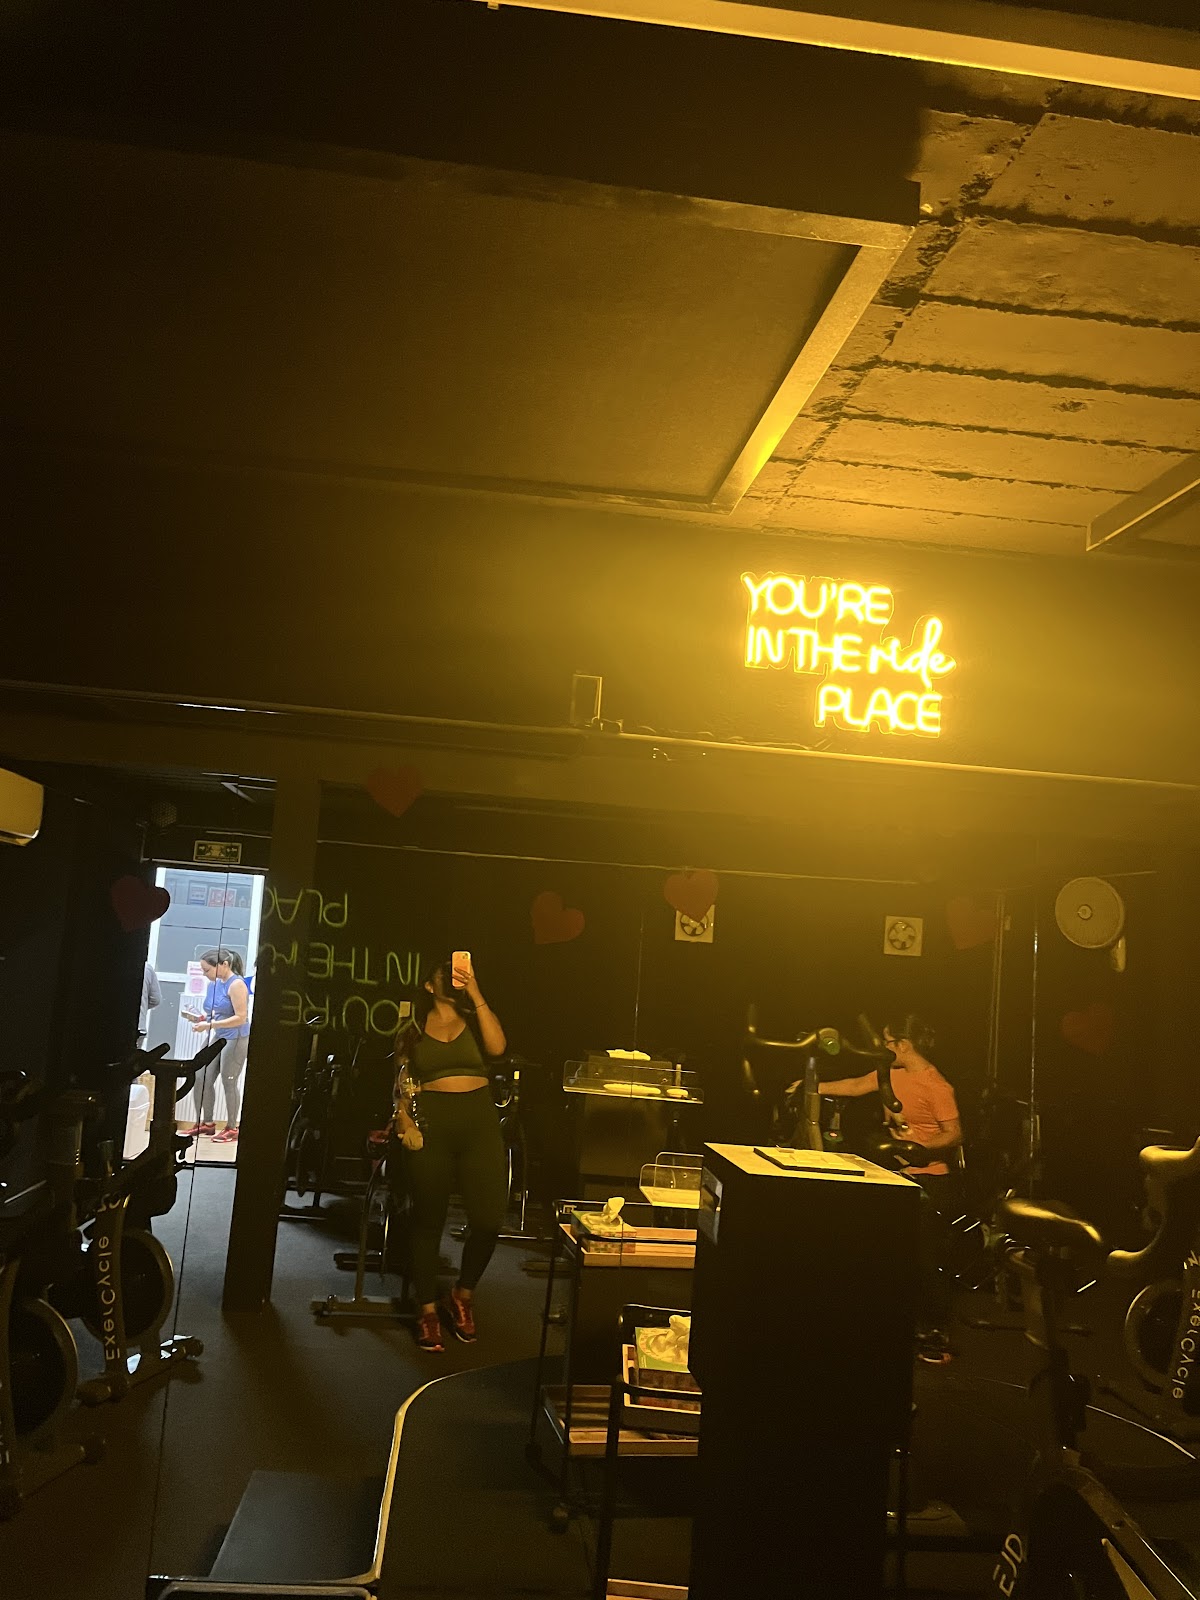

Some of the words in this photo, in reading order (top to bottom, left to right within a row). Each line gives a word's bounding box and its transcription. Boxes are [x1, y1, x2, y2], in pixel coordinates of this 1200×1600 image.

[742, 574, 892, 625] YOU'RE
[745, 624, 784, 665] IN
[786, 626, 864, 672] THE
[867, 616, 957, 690] ride
[815, 682, 943, 733] PLACE
